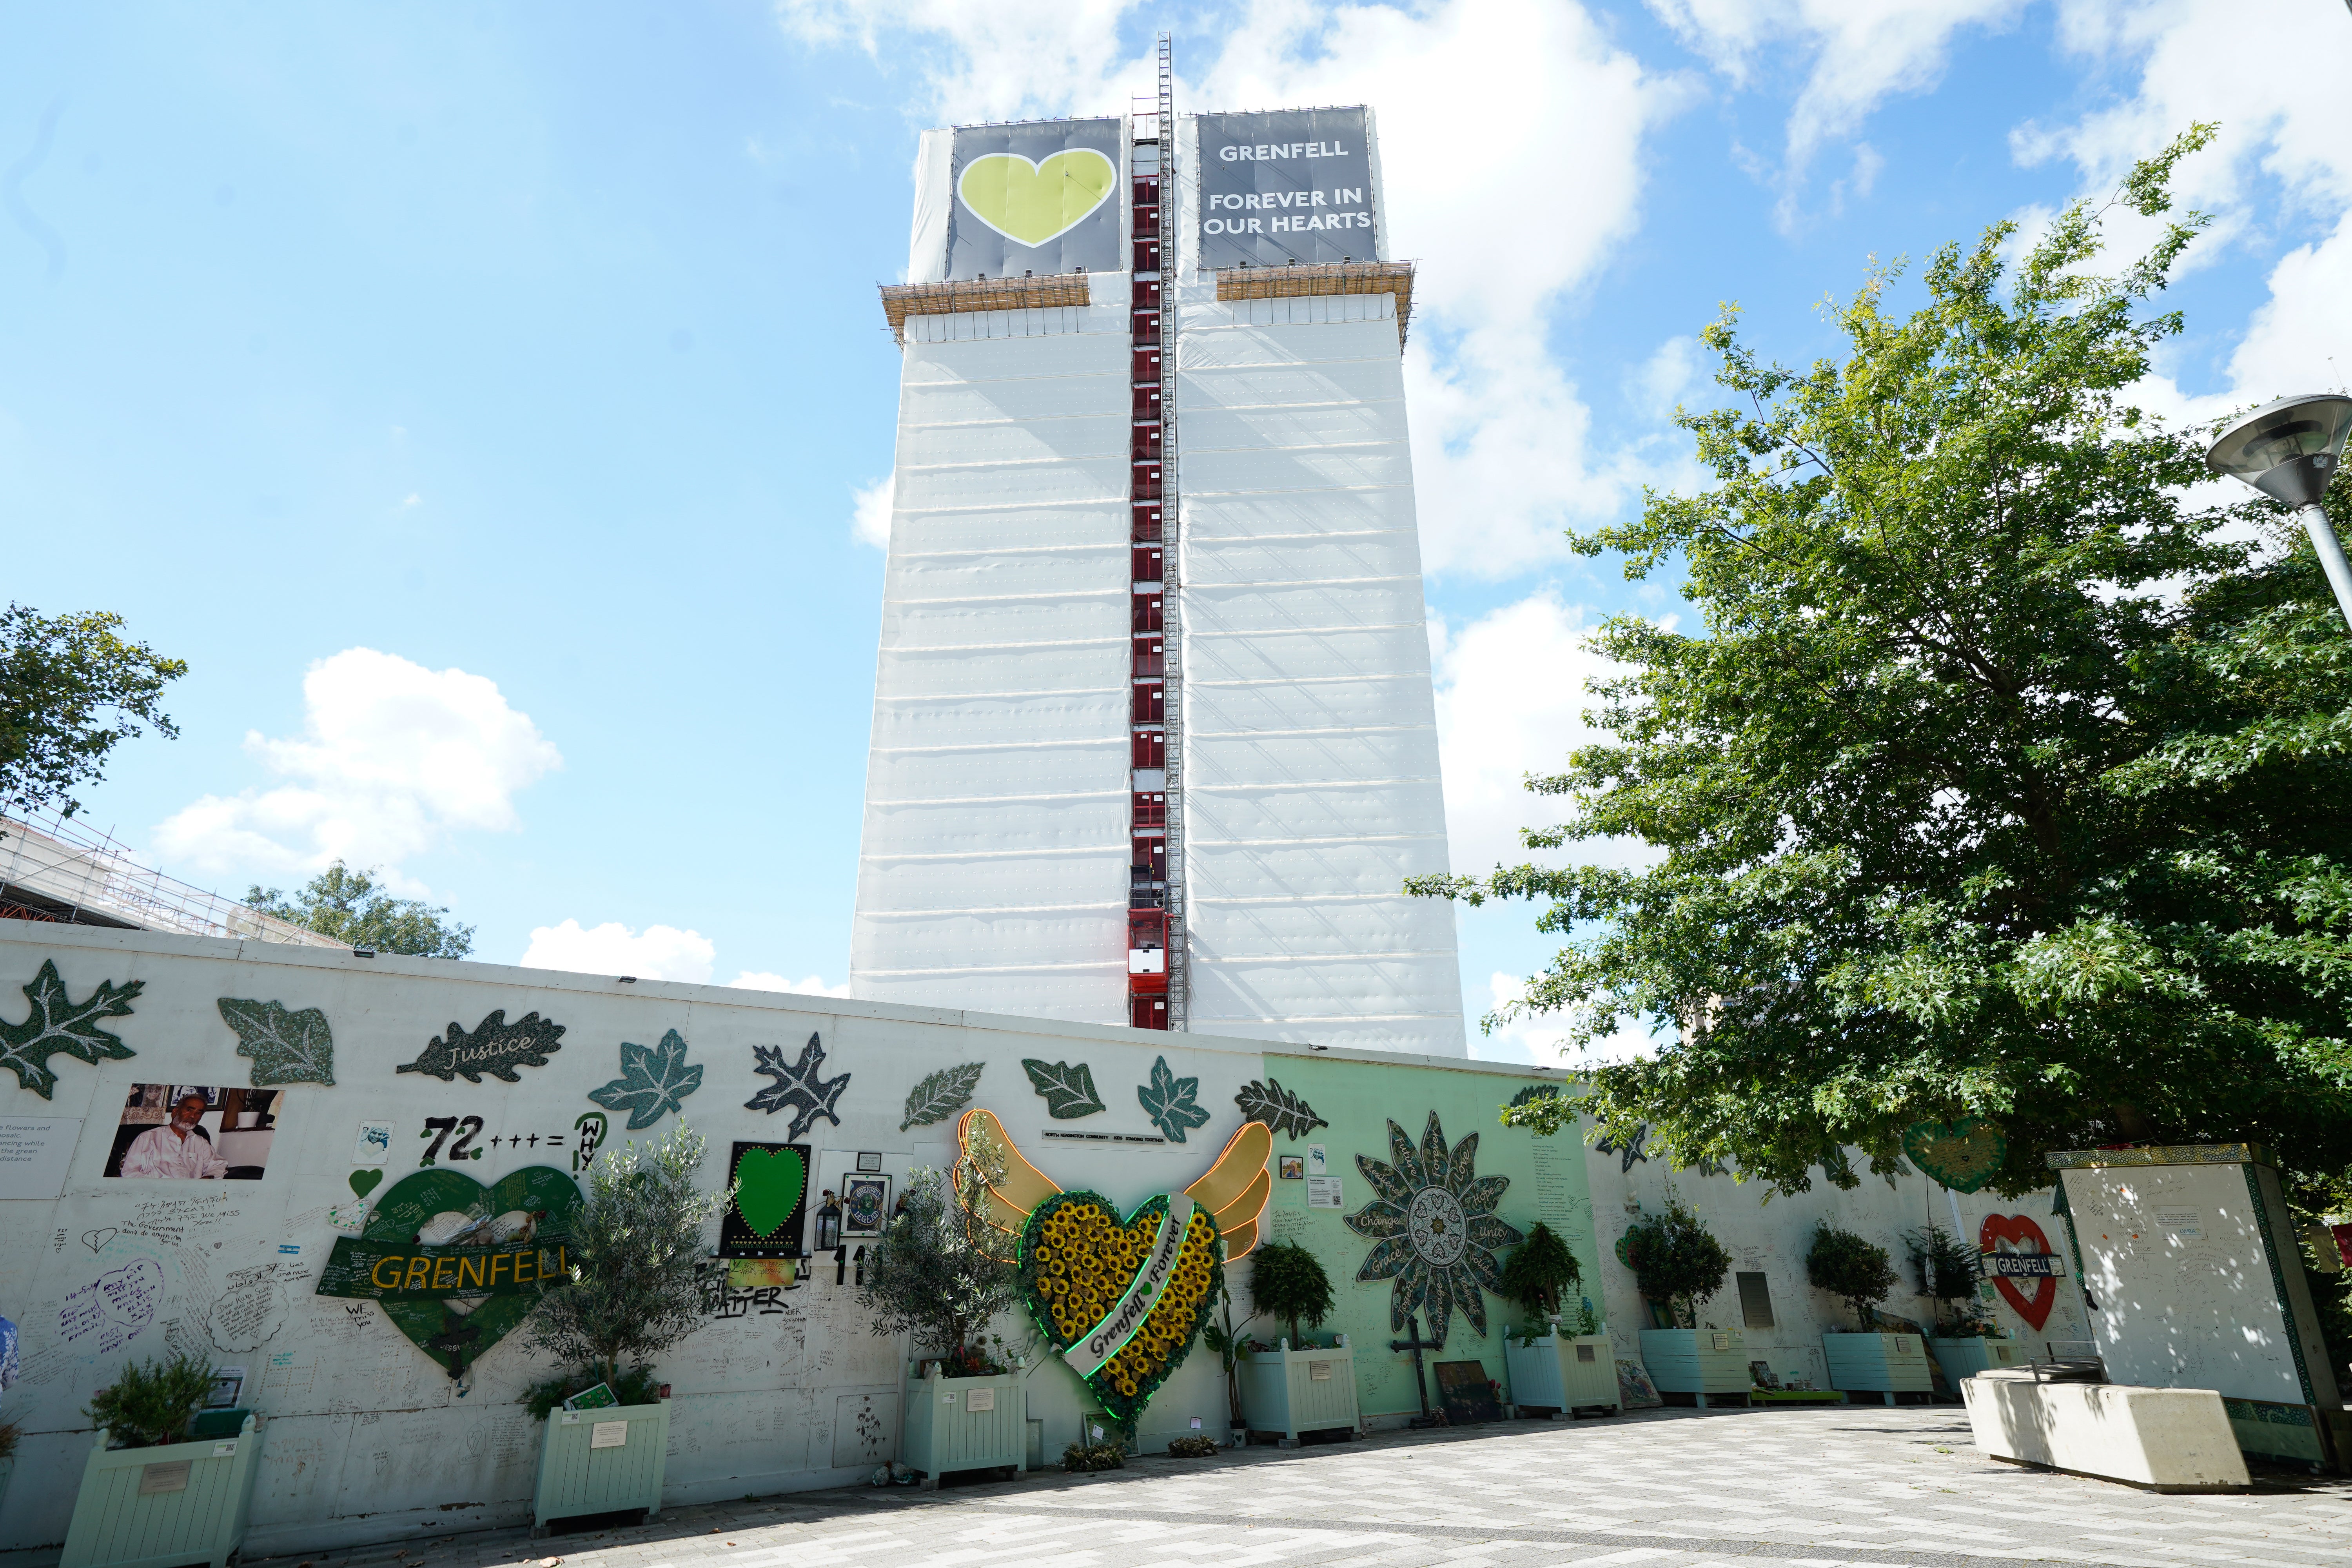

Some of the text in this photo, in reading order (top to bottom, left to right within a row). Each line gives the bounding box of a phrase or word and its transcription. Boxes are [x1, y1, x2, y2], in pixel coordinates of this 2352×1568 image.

[1219, 140, 1349, 162] GRENFELL
[1210, 187, 1362, 210] FOREVER IN
[1203, 211, 1371, 235] OUR HEARTS
[444, 1035, 537, 1071] Justice
[423, 1115, 485, 1160] 72
[1395, 1136, 1417, 1177] Future
[1432, 1129, 1441, 1176] Forever
[1453, 1149, 1470, 1181] Love
[1367, 1164, 1403, 1197] Resilience
[856, 1186, 882, 1200] GRENFELL
[1473, 1186, 1495, 1206] Hope
[138, 1221, 184, 1233] Government
[854, 1210, 880, 1224] LEGEND
[1361, 1215, 1400, 1229] Change
[152, 1232, 182, 1242] anything
[1479, 1226, 1508, 1241] Unity
[1372, 1248, 1402, 1273] Grace
[1998, 1258, 2049, 1273] GRENFELL
[1090, 1214, 1181, 1359] Grenfell Forever
[1397, 1271, 1421, 1315] Together
[1459, 1275, 1481, 1316] Respect
[216, 1301, 234, 1314] Dear
[345, 1302, 369, 1314] WE
[353, 1310, 375, 1322] miss
[785, 1308, 801, 1316] NEVER
[1435, 1281, 1445, 1333] Courage
[357, 1320, 372, 1331] you
